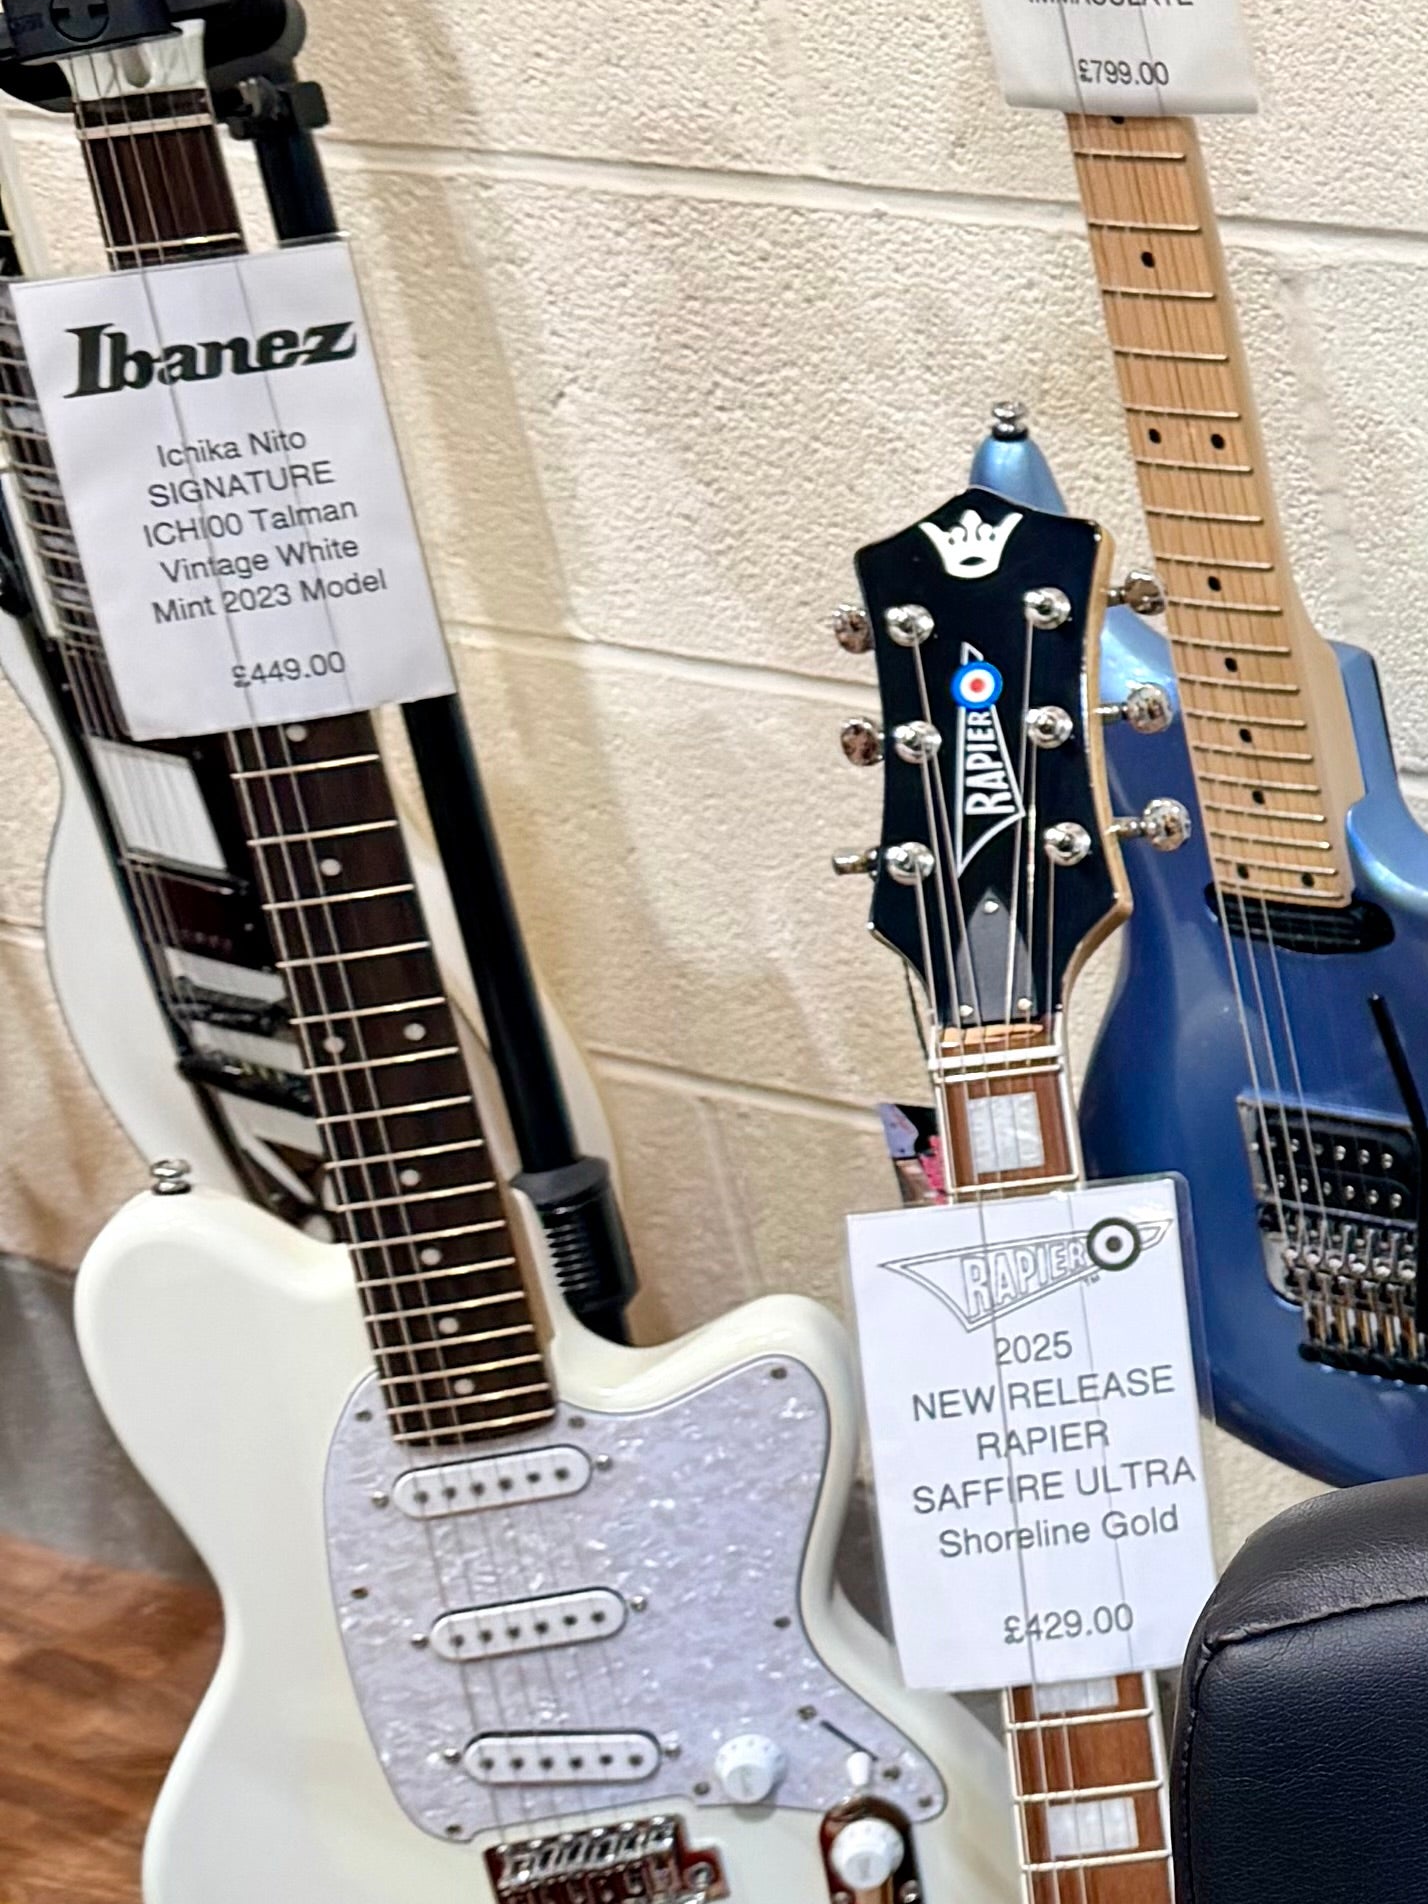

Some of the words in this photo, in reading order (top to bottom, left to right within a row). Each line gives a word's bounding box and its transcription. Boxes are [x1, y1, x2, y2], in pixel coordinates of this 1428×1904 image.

[1078, 59, 1170, 86] £799.00
[64, 321, 358, 399] Ibanez
[157, 436, 242, 468] Ichika
[249, 428, 307, 458] Nito
[148, 459, 336, 508] SIGNATURE
[143, 512, 243, 548] ICHI00
[249, 497, 358, 533] Talman
[160, 549, 269, 584] Vintage
[277, 535, 359, 567] White
[153, 593, 216, 625] Mint
[224, 586, 292, 615] 2023
[301, 568, 387, 602] Model
[232, 650, 346, 688] £449.00
[965, 711, 1016, 815] RAPIER
[961, 1238, 1088, 1319] RAPIER
[994, 1329, 1073, 1366] 2025
[913, 1384, 995, 1422] NEW
[1008, 1364, 1175, 1410] RELEASE
[977, 1419, 1110, 1460] RAPIER
[913, 1470, 1064, 1515] SAFFIRE
[1075, 1456, 1197, 1496] ULTRA
[938, 1515, 1090, 1559] Shoreline
[1102, 1504, 1178, 1539] Gold
[1003, 1603, 1134, 1644] £429.00
